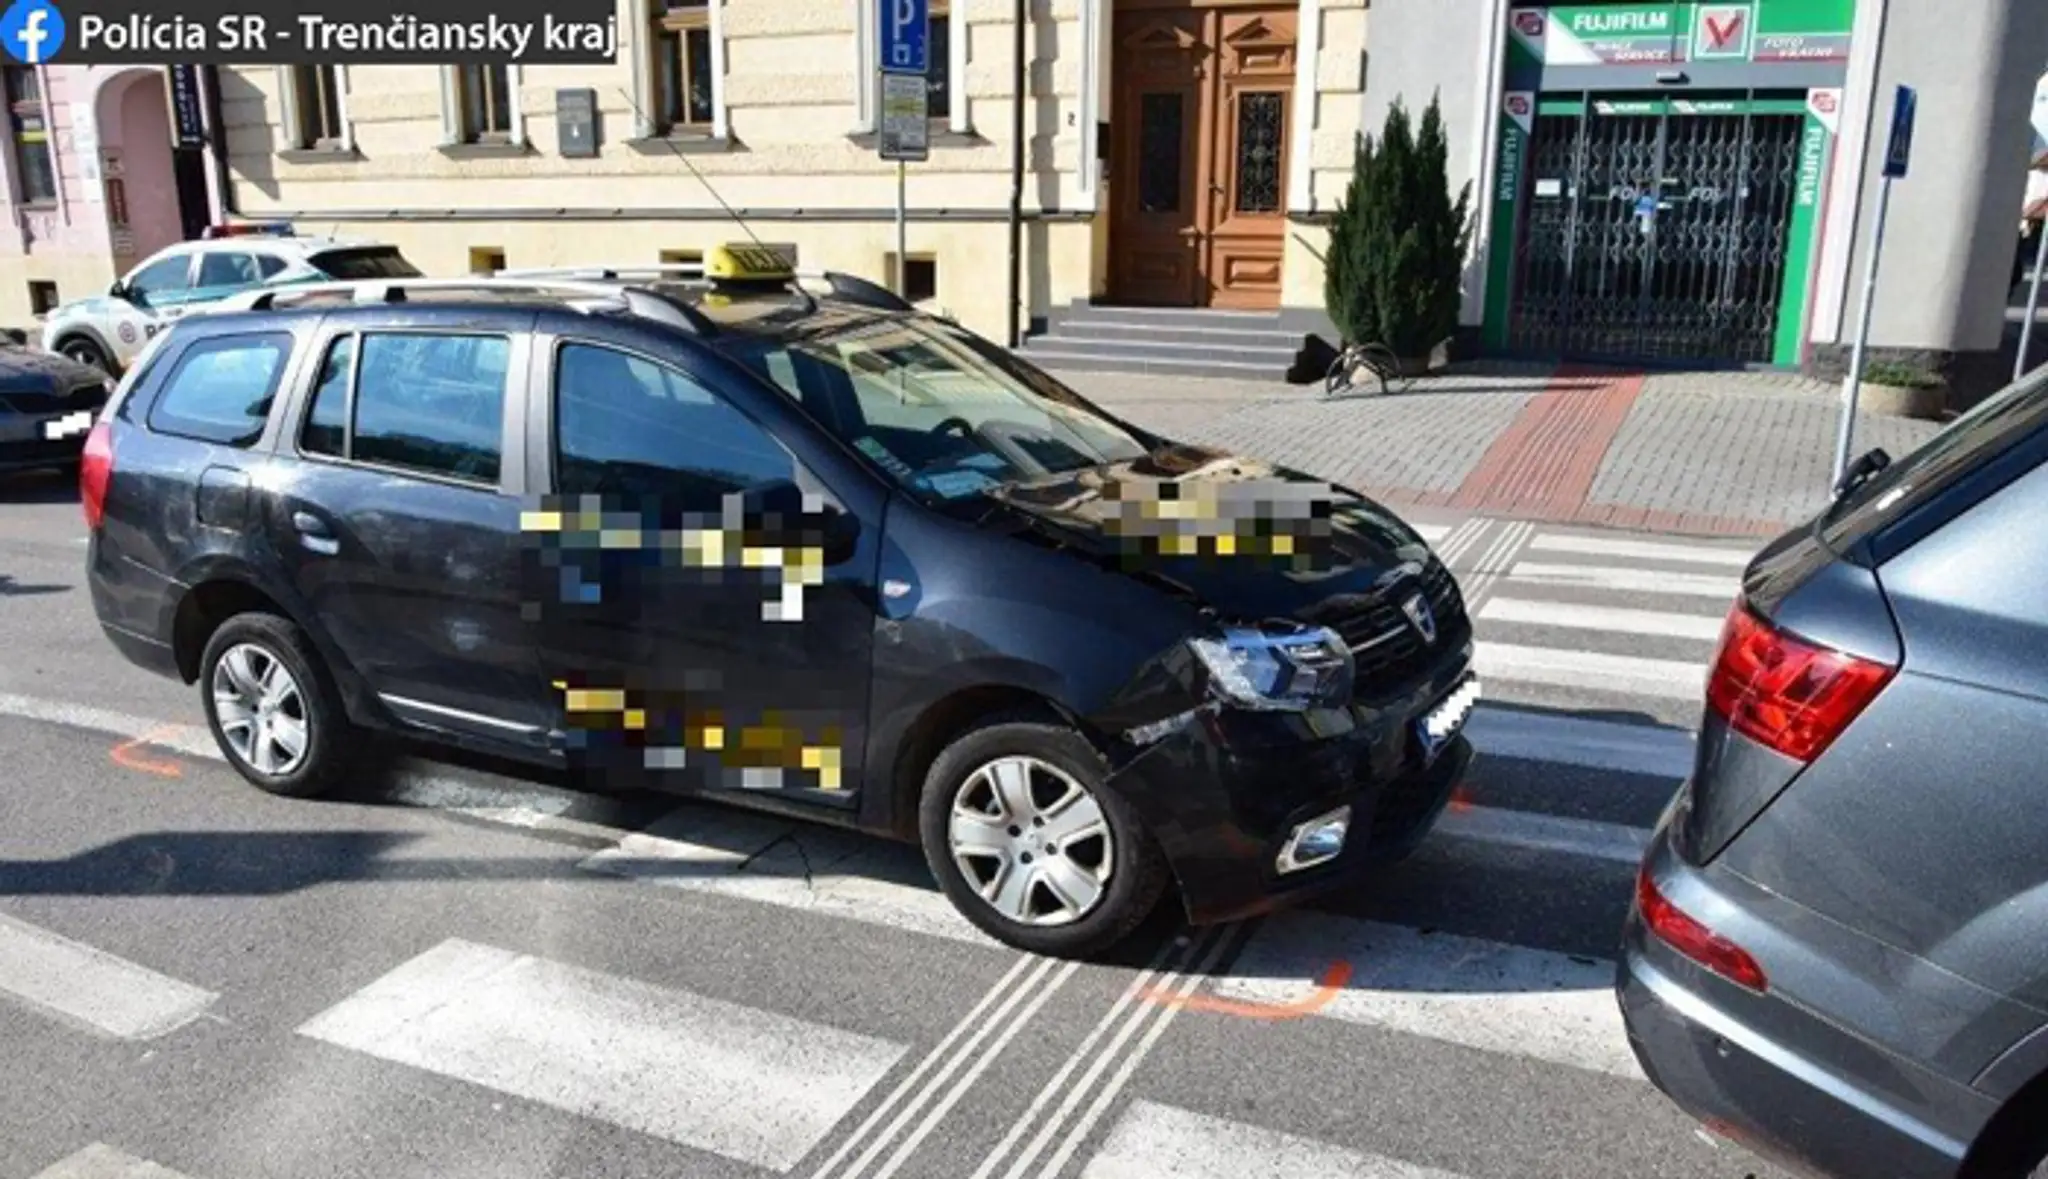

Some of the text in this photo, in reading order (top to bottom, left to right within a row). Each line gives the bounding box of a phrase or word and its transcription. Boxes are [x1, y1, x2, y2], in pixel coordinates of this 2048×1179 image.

[1573, 11, 1669, 31] FUJIFILM
[1500, 127, 1518, 201] FUJIFILM
[1799, 126, 1823, 206] FUJIFILM
